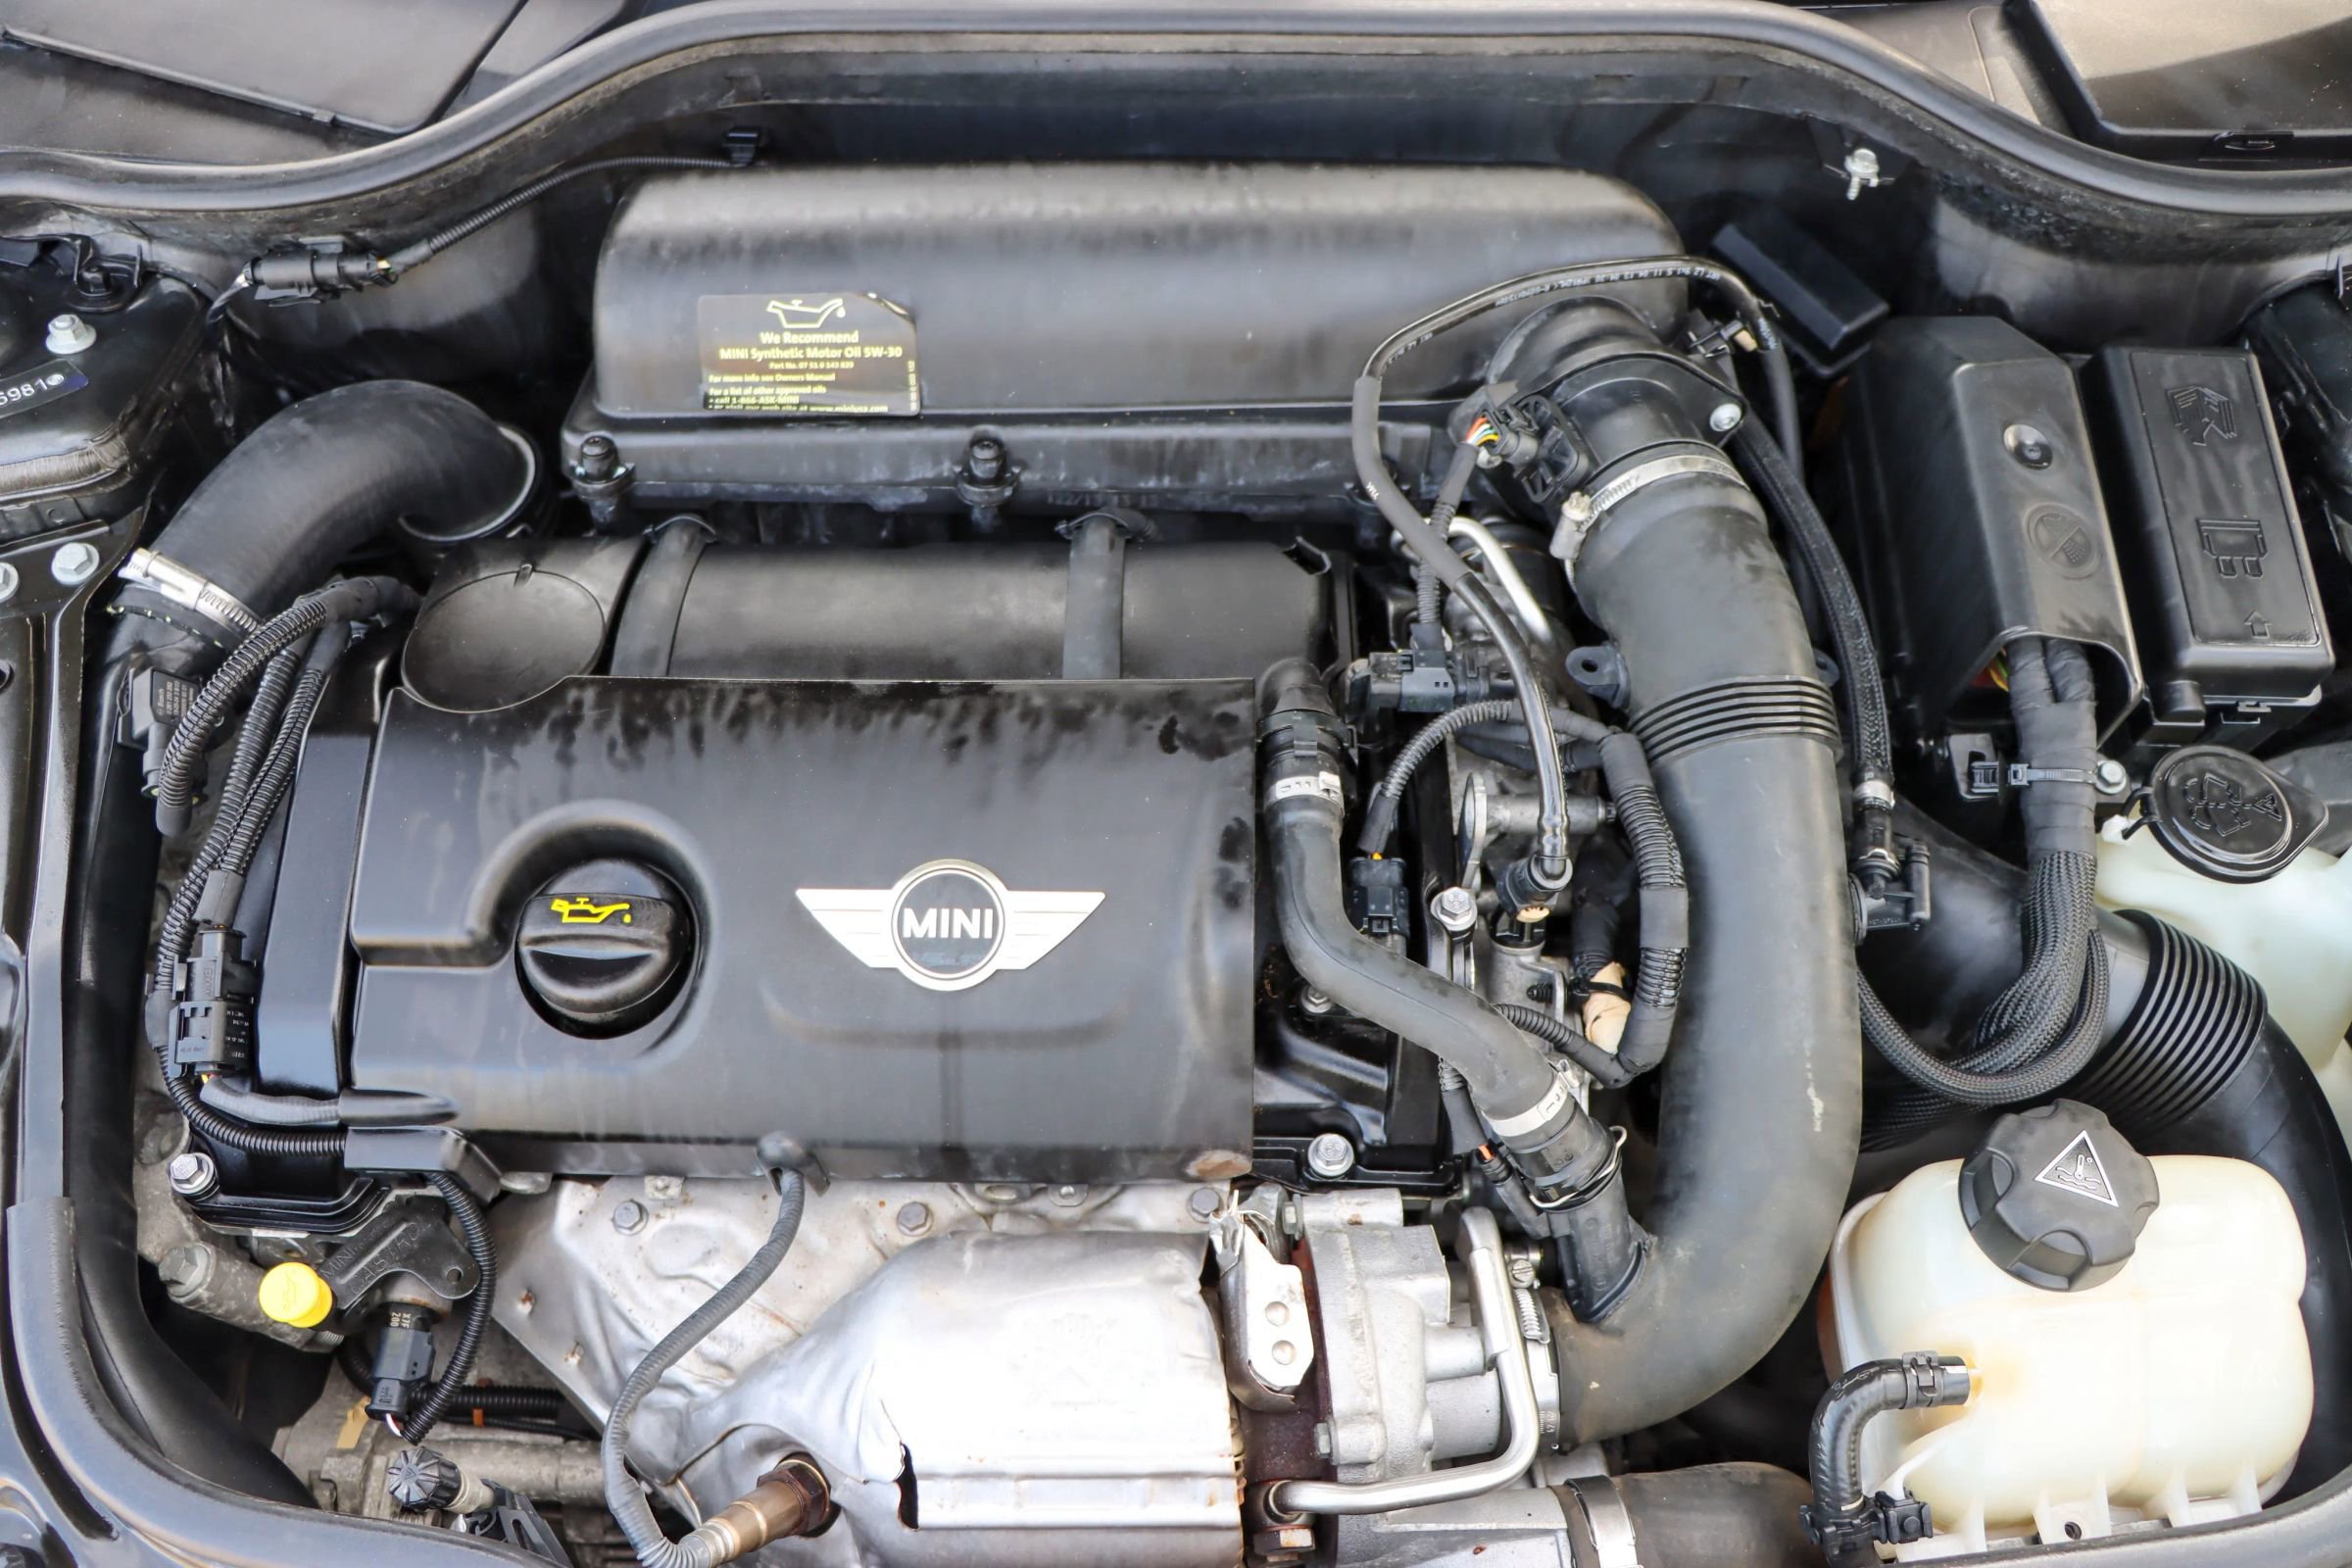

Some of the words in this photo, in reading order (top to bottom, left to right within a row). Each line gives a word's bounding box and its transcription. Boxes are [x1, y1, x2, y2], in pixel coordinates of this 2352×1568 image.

[760, 331, 781, 344] We
[783, 329, 859, 344] Recommend
[719, 347, 749, 360] MINI
[750, 347, 804, 363] Synthetic
[806, 347, 842, 359] Motor
[844, 346, 862, 359] Oil
[863, 345, 903, 359] 5W-30
[768, 361, 784, 369] Part
[903, 907, 994, 939] MINI
[319, 1247, 357, 1280] MINI
